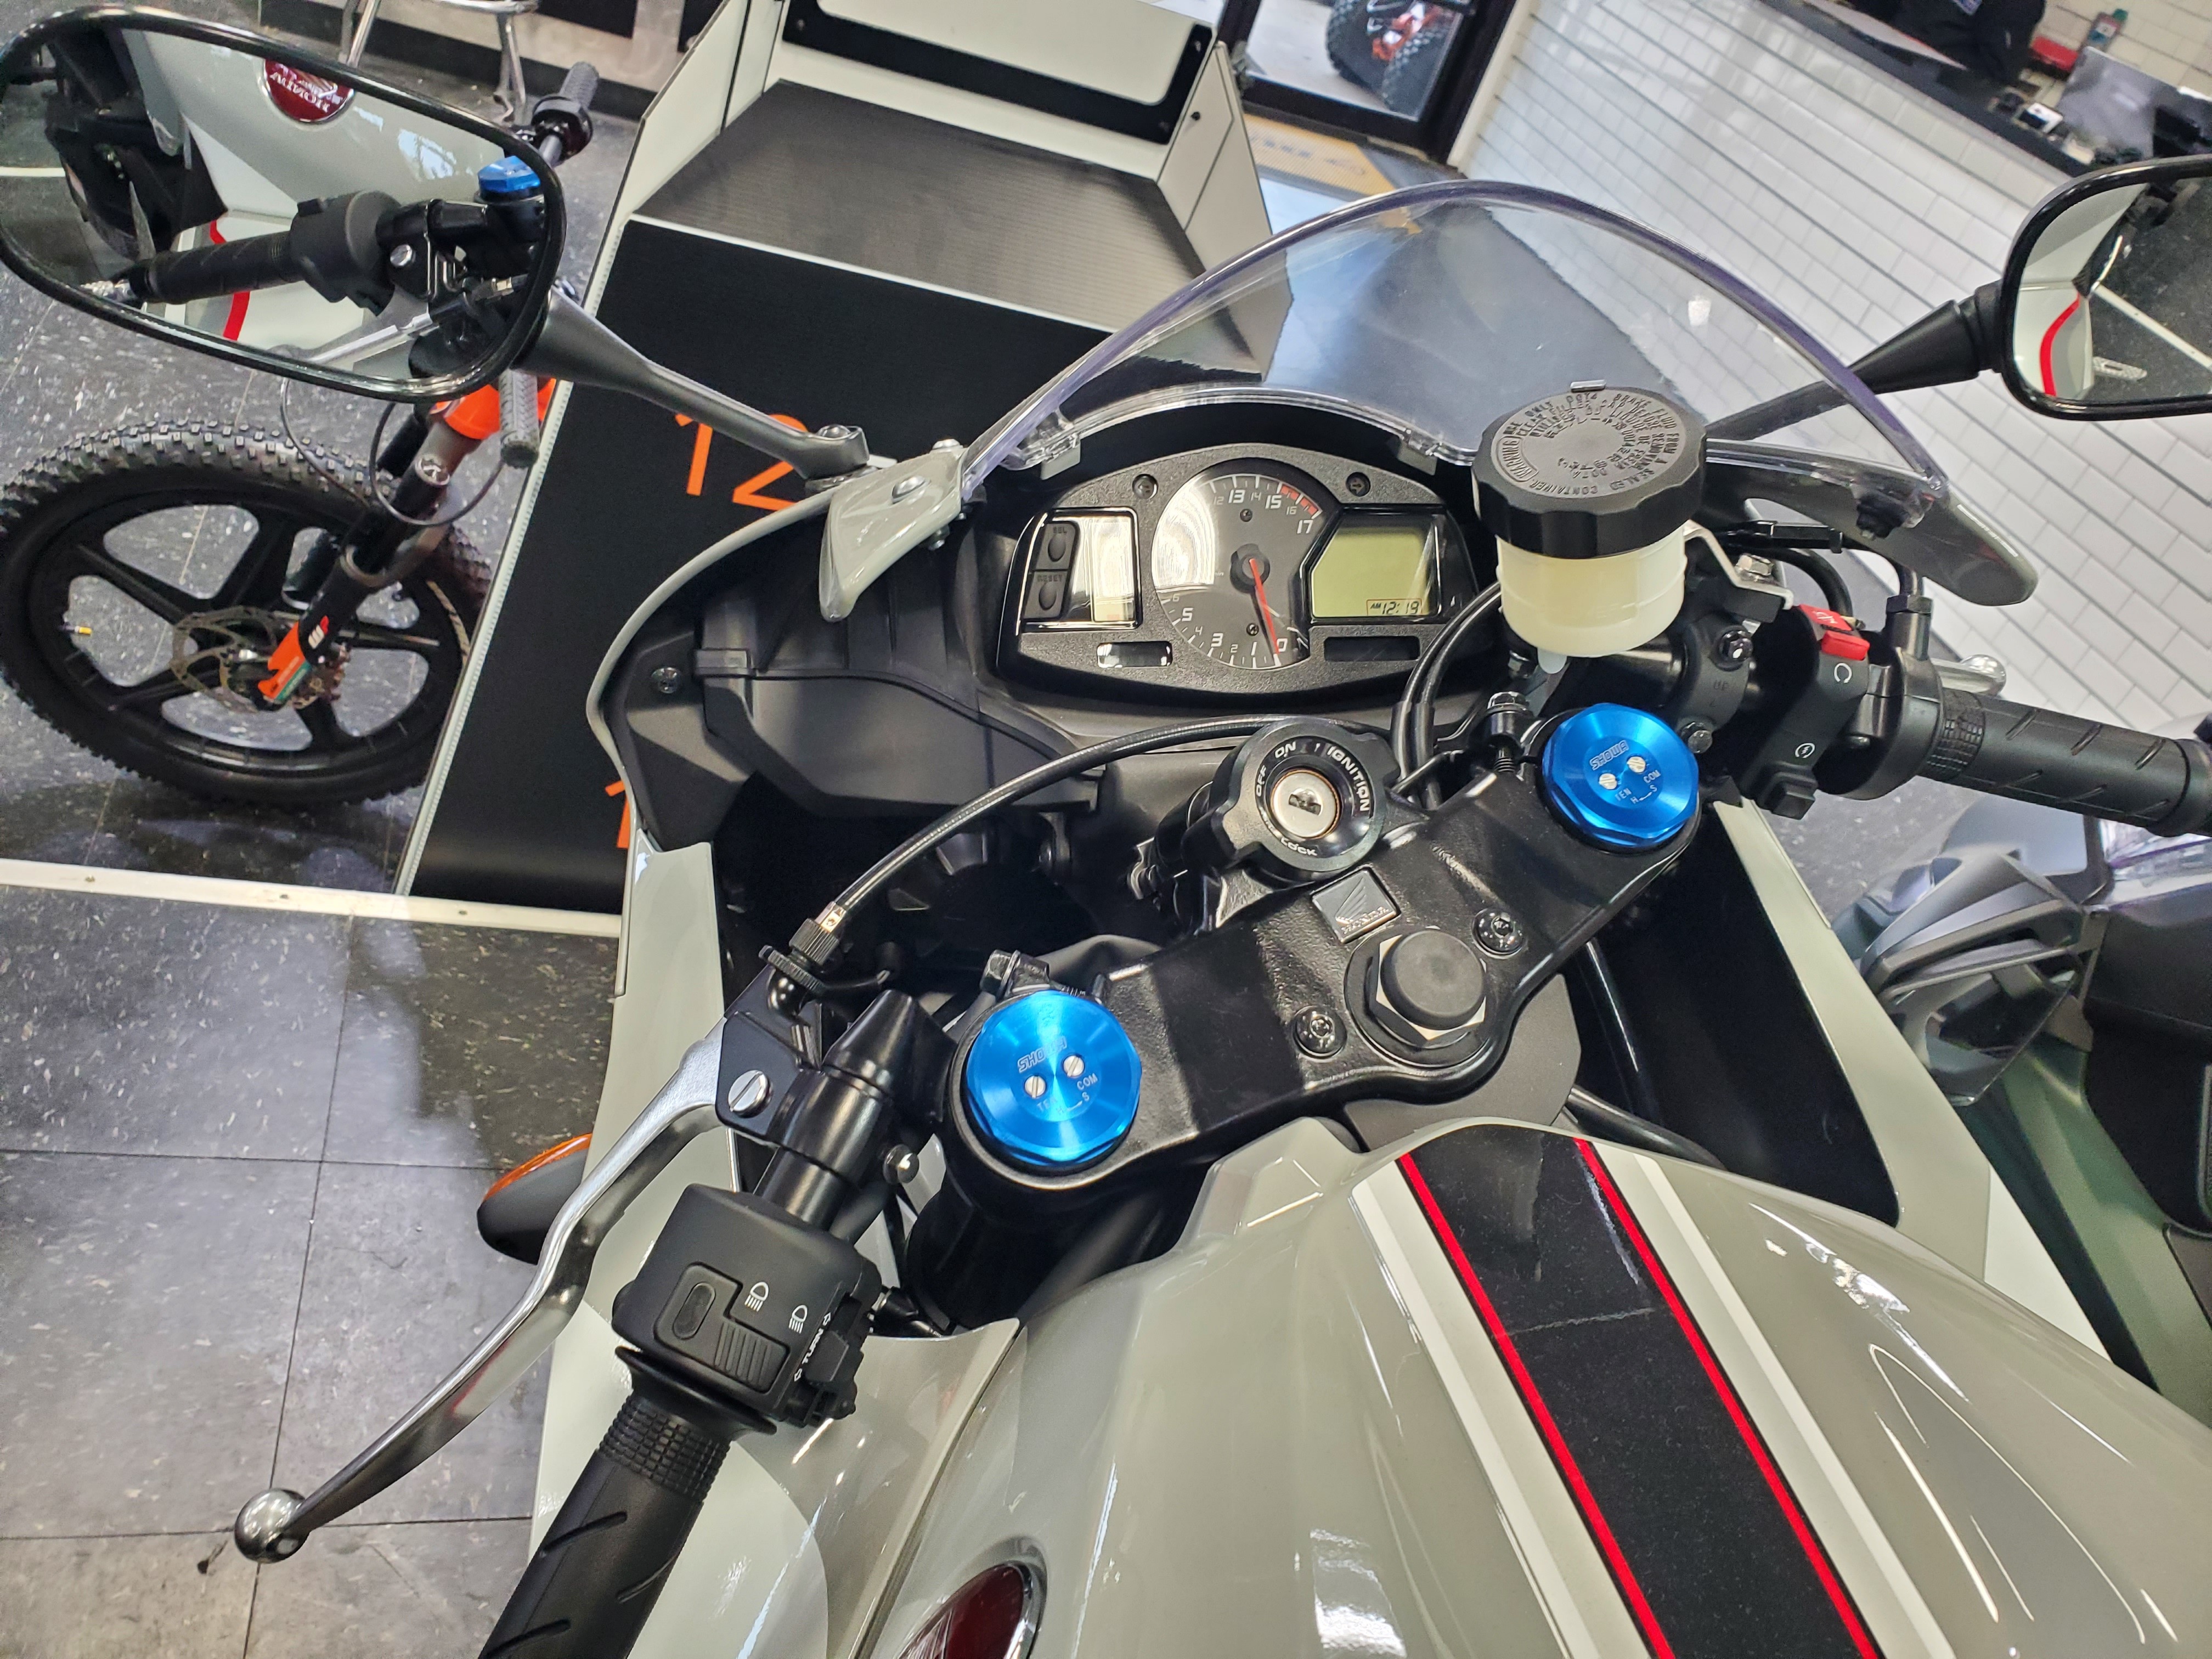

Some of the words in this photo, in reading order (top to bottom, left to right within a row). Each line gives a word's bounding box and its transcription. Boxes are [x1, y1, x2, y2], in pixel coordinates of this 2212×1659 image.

[1525, 402, 1554, 417] ONLY
[1646, 409, 1677, 429] FLUID
[1664, 433, 1680, 454] FROM
[1502, 441, 1532, 478] WARNING
[1610, 469, 1655, 490] SEALED
[1213, 496, 1224, 505] 12
[1228, 490, 1245, 503] 13
[1250, 492, 1262, 501] 14
[1265, 495, 1282, 509] 15
[1286, 506, 1296, 515] 16
[1296, 520, 1313, 534] 17
[1172, 594, 1180, 602] 6
[1182, 607, 1193, 622] 5
[1382, 601, 1419, 614] 12:19
[1195, 626, 1203, 635] 4
[1211, 633, 1223, 647] 3
[1276, 638, 1288, 652] 0
[1230, 644, 1238, 653] 2
[1251, 641, 1257, 656] 1
[1274, 742, 1296, 758] ON
[1589, 740, 1629, 770] SHOWA
[1256, 765, 1267, 797] OFF
[1327, 746, 1370, 811] IGNITION
[1643, 770, 1661, 783] COM
[1615, 788, 1632, 801] TEN
[1650, 785, 1657, 793] S
[1281, 837, 1318, 856] LOCK
[1018, 1036, 1067, 1073] SHOWA
[1077, 1073, 1098, 1091] COM
[1082, 1092, 1090, 1102] S
[802, 1328, 823, 1364] TURN
